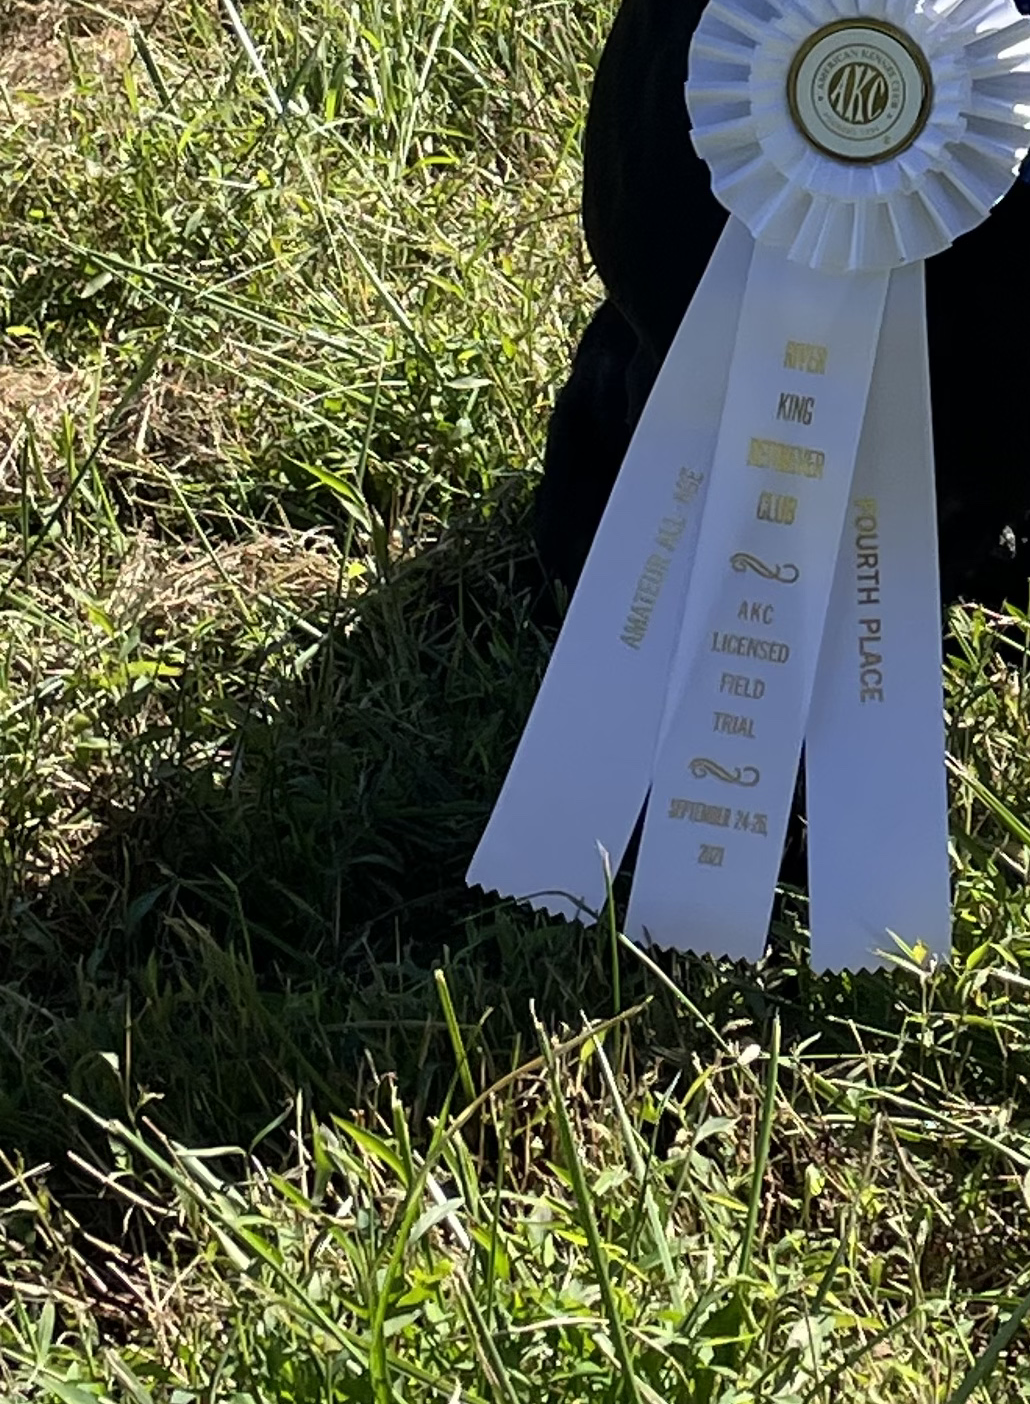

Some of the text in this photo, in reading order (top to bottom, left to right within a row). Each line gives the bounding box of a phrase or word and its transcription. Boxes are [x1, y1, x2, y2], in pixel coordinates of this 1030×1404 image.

[816, 49, 859, 90] AMERICAN
[829, 64, 886, 123] AKC
[783, 340, 828, 375] RIVER
[776, 392, 815, 425] KING
[756, 491, 797, 525] CLUB
[620, 553, 672, 651] AMATEUR
[737, 600, 775, 624] AKC
[854, 497, 884, 703] FOURTH PLACE
[710, 631, 790, 664] LICENSED
[719, 672, 765, 700] FIELD
[712, 711, 755, 738] TRIAL
[667, 797, 730, 828] SEPTEMBER
